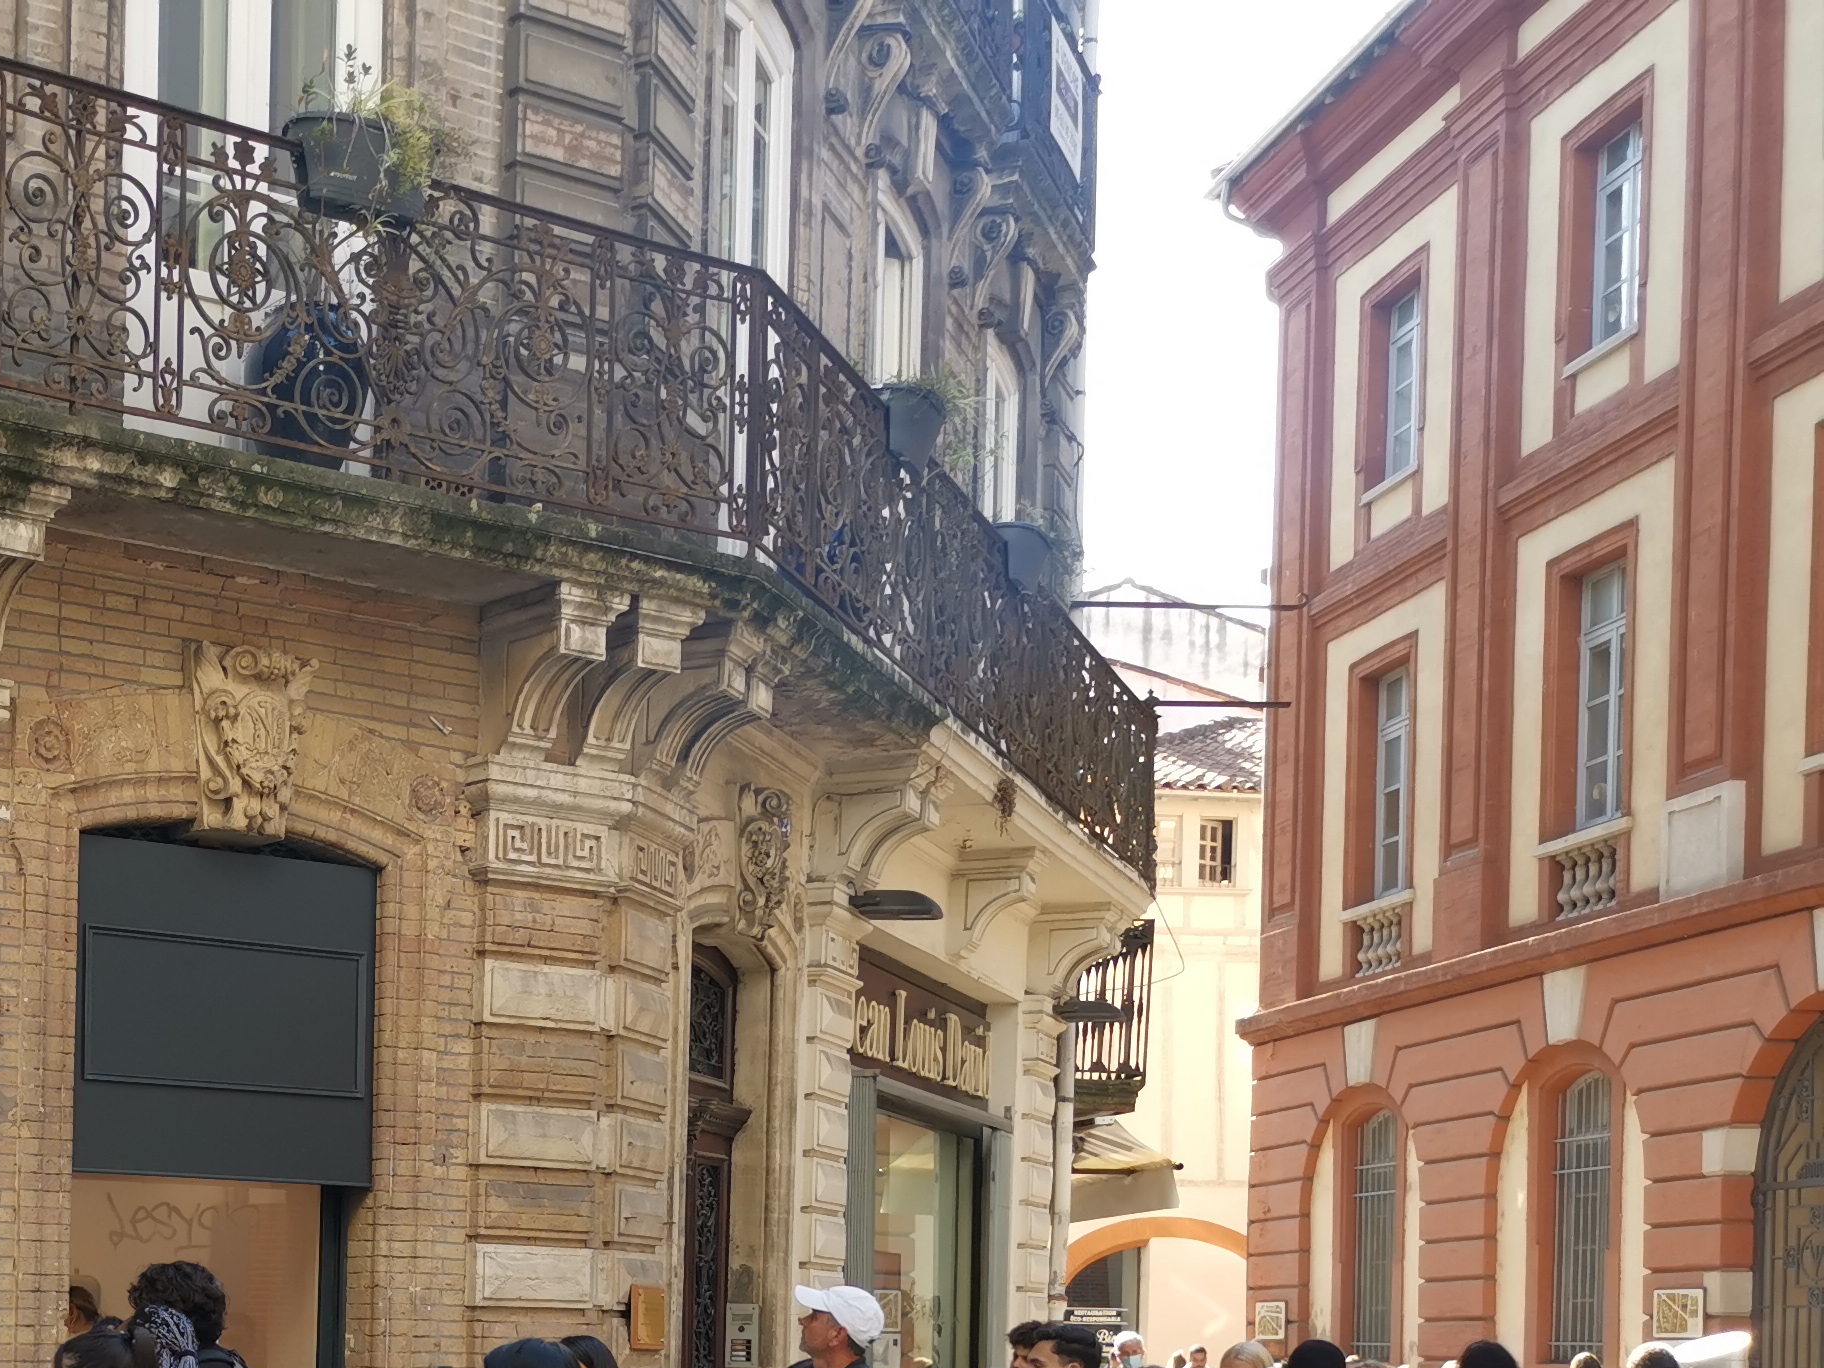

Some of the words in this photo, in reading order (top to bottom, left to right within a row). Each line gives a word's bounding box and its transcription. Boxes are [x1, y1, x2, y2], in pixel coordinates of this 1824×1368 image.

[855, 995, 891, 1063] ean
[893, 989, 944, 1083] Louis
[940, 1012, 993, 1100] David
